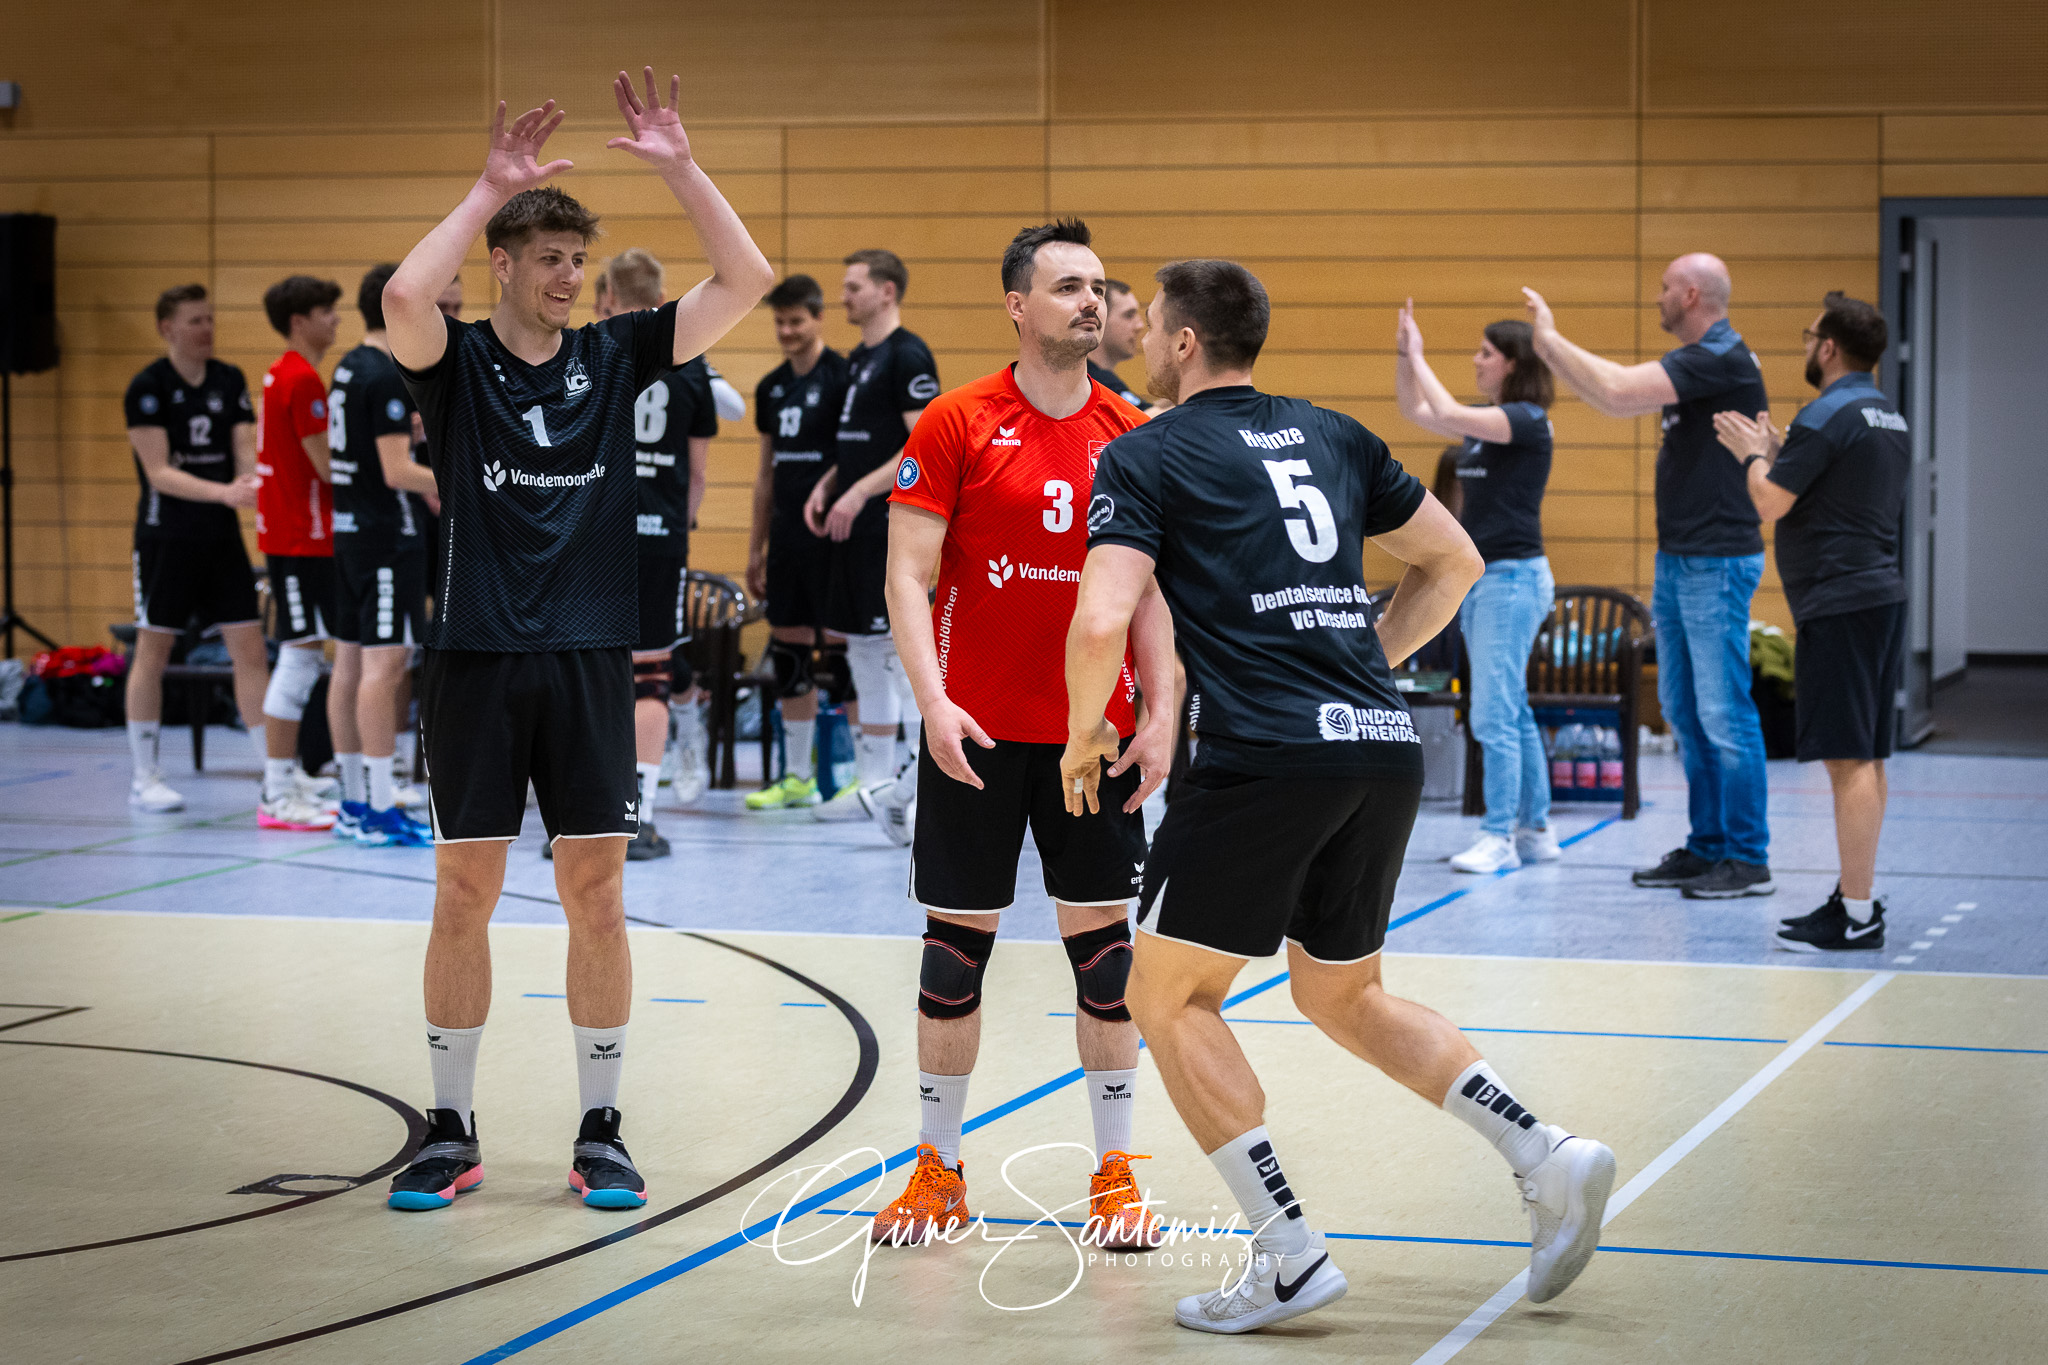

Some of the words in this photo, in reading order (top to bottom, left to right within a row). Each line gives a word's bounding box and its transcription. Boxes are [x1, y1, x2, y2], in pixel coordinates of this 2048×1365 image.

[189, 415, 212, 446] 12
[522, 405, 552, 447] 1
[991, 437, 1022, 447] erima
[1237, 427, 1306, 450] Heinze
[1042, 479, 1074, 533] 3
[1261, 458, 1339, 564] 5
[1250, 584, 1353, 613] Dentalservice
[1289, 609, 1316, 630] VC
[1314, 608, 1367, 628] Dresden
[1354, 708, 1414, 727] INDOOR
[590, 1051, 622, 1060] erima
[1102, 1091, 1132, 1101] erima
